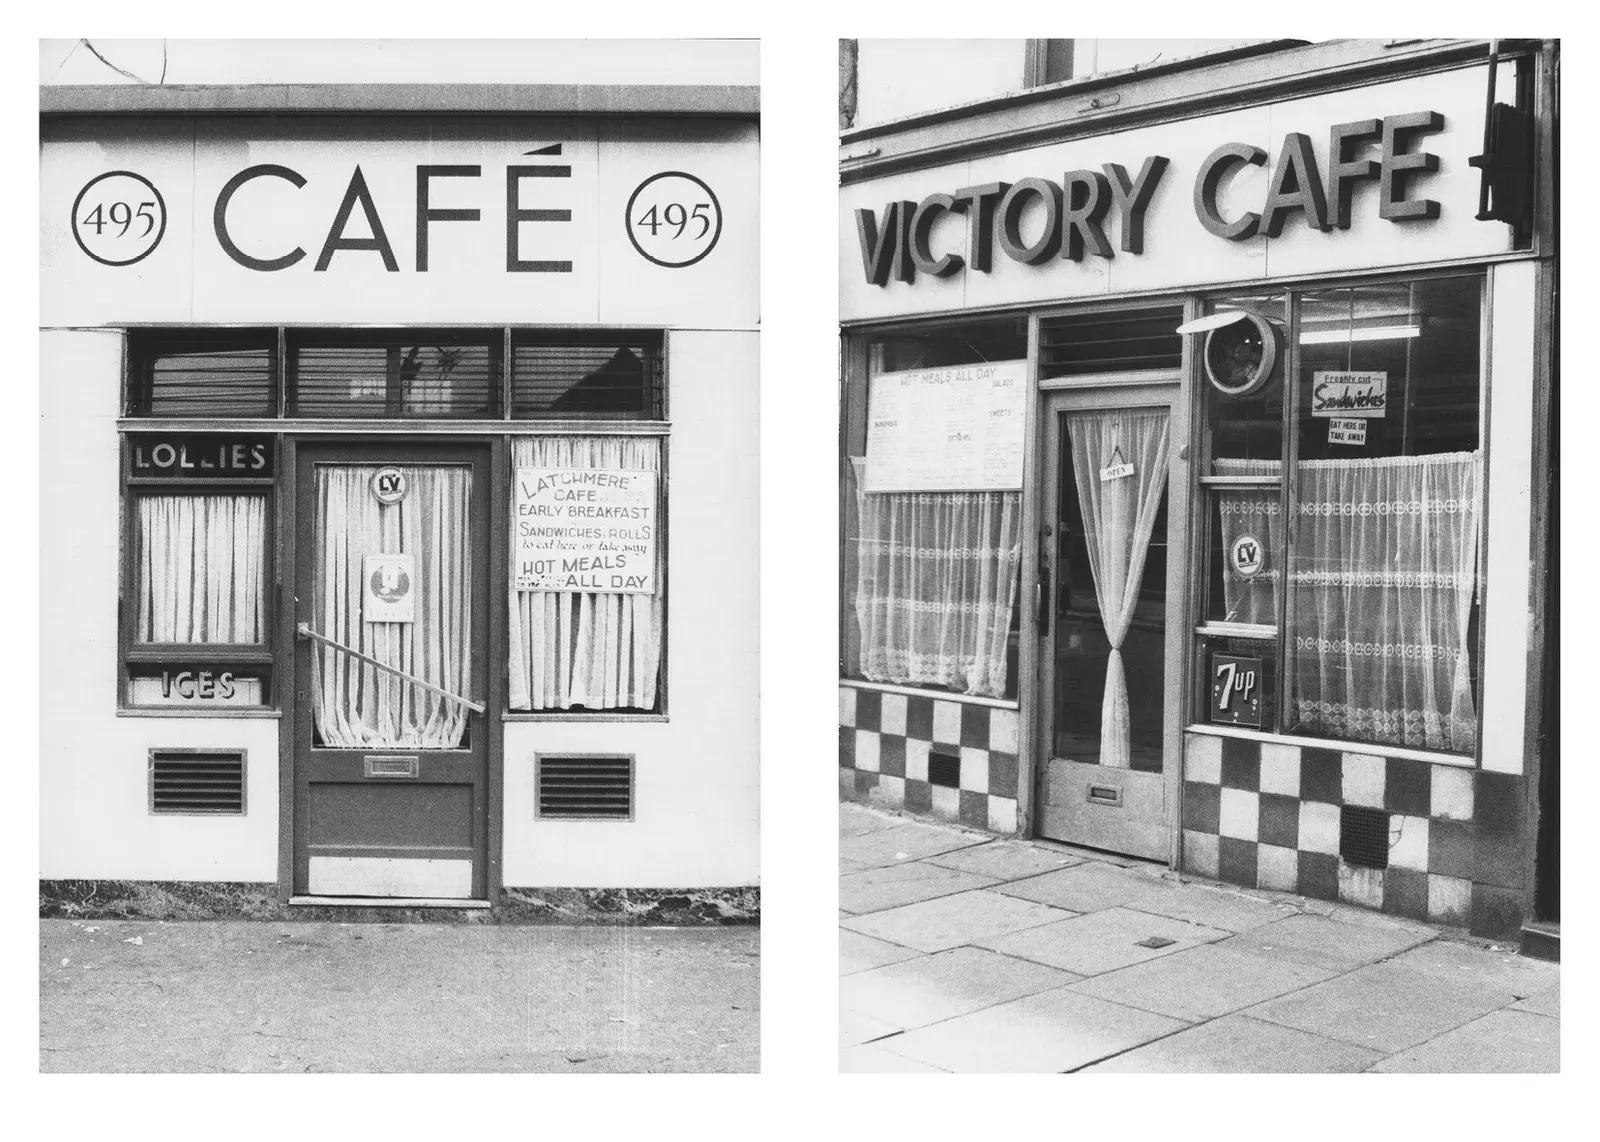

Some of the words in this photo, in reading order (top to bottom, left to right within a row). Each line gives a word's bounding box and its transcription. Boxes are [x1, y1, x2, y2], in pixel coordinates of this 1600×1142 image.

[854, 155, 1170, 287] VICTORY
[1194, 111, 1444, 242] CAFE
[214, 143, 572, 273] CAFÉ
[83, 201, 156, 239] 495
[637, 202, 712, 241] 495
[956, 369, 974, 381] ALL
[977, 367, 997, 380] DAY
[1314, 383, 1385, 410] Sandwiches
[1343, 422, 1357, 430] HERE
[1358, 422, 1366, 430] OR
[1330, 432, 1345, 440] TAKE
[1347, 433, 1364, 441] AWAY
[379, 475, 400, 492] LV
[521, 472, 630, 500] LATCHMERE
[554, 489, 597, 502] CAFE
[519, 504, 563, 517] EARLY
[568, 505, 650, 519] BREAKFAST
[608, 526, 651, 540] ROLLS
[1238, 546, 1256, 563] LV
[523, 559, 556, 575] HOT
[562, 554, 627, 573] MEALS
[565, 574, 602, 588] ALL
[611, 575, 648, 589] DAY
[162, 671, 235, 699] ICES
